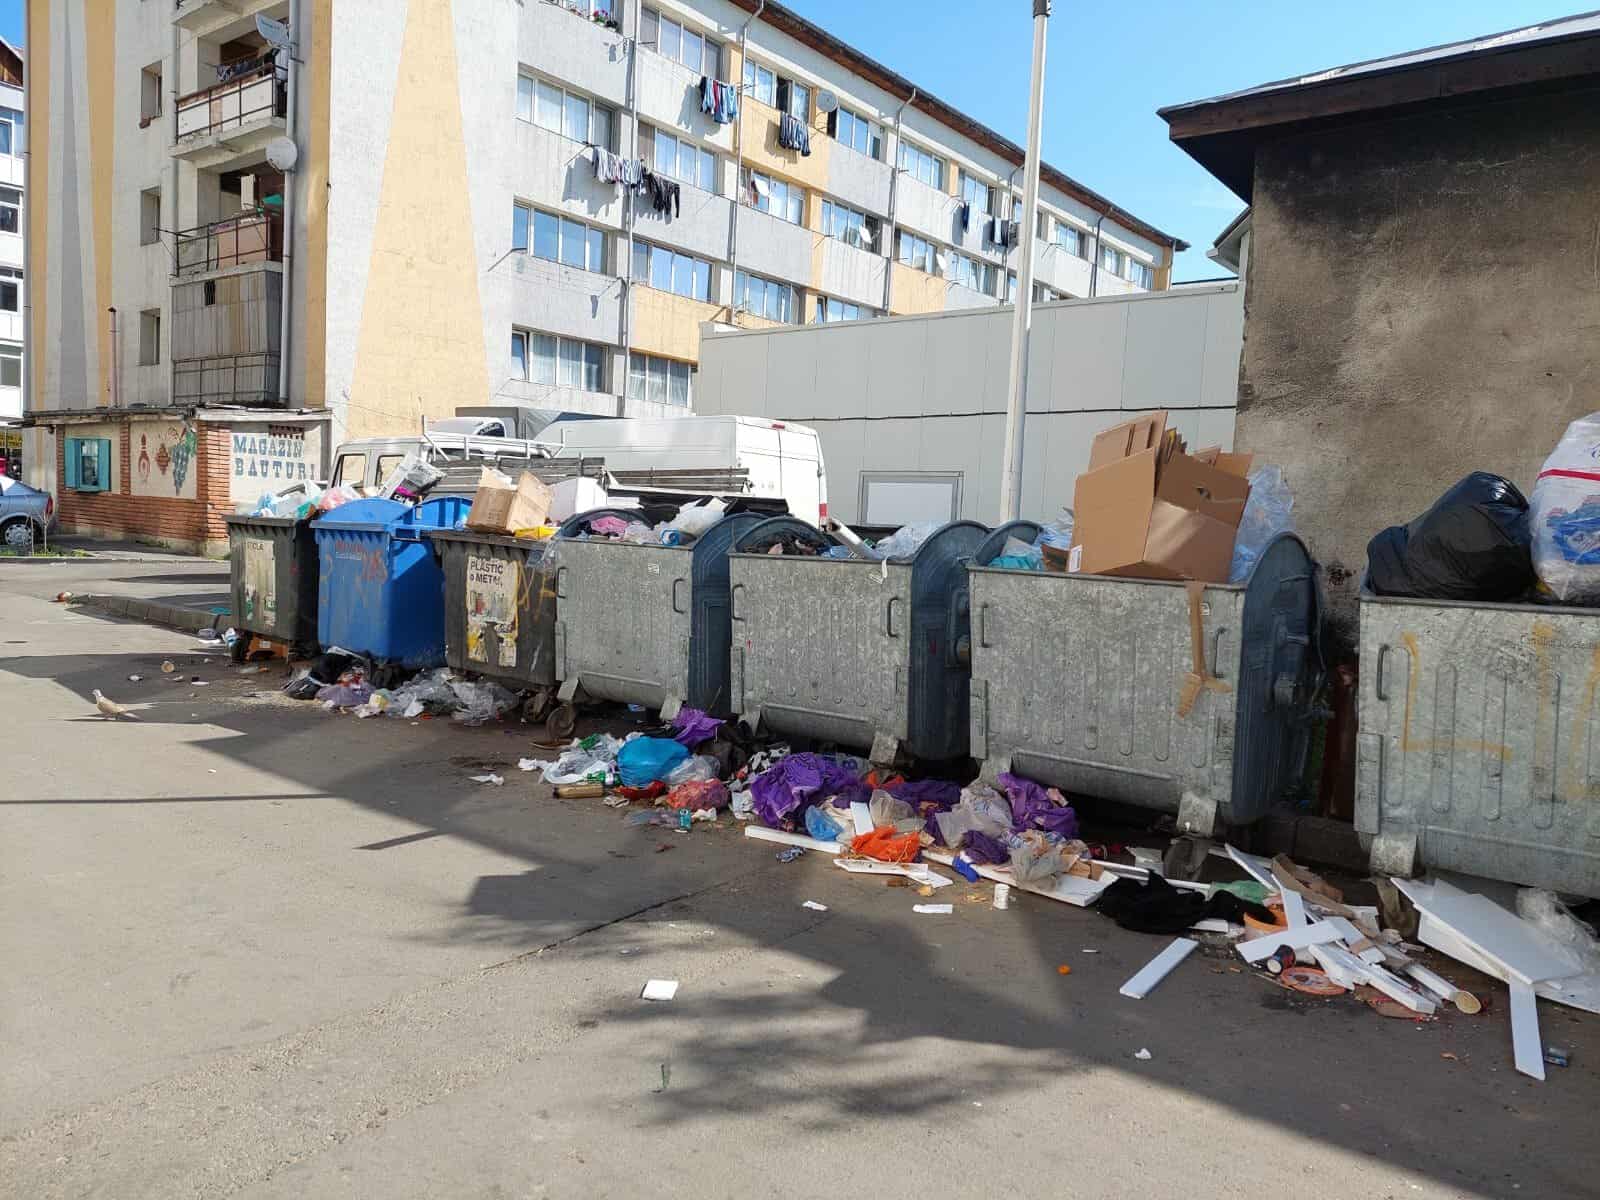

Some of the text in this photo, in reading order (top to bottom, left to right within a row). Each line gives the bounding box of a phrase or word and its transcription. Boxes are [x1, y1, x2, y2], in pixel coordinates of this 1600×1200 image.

[233, 434, 304, 458] MAGAZIN
[234, 457, 315, 480] BAUTURI
[471, 559, 504, 575] PLASTIC
